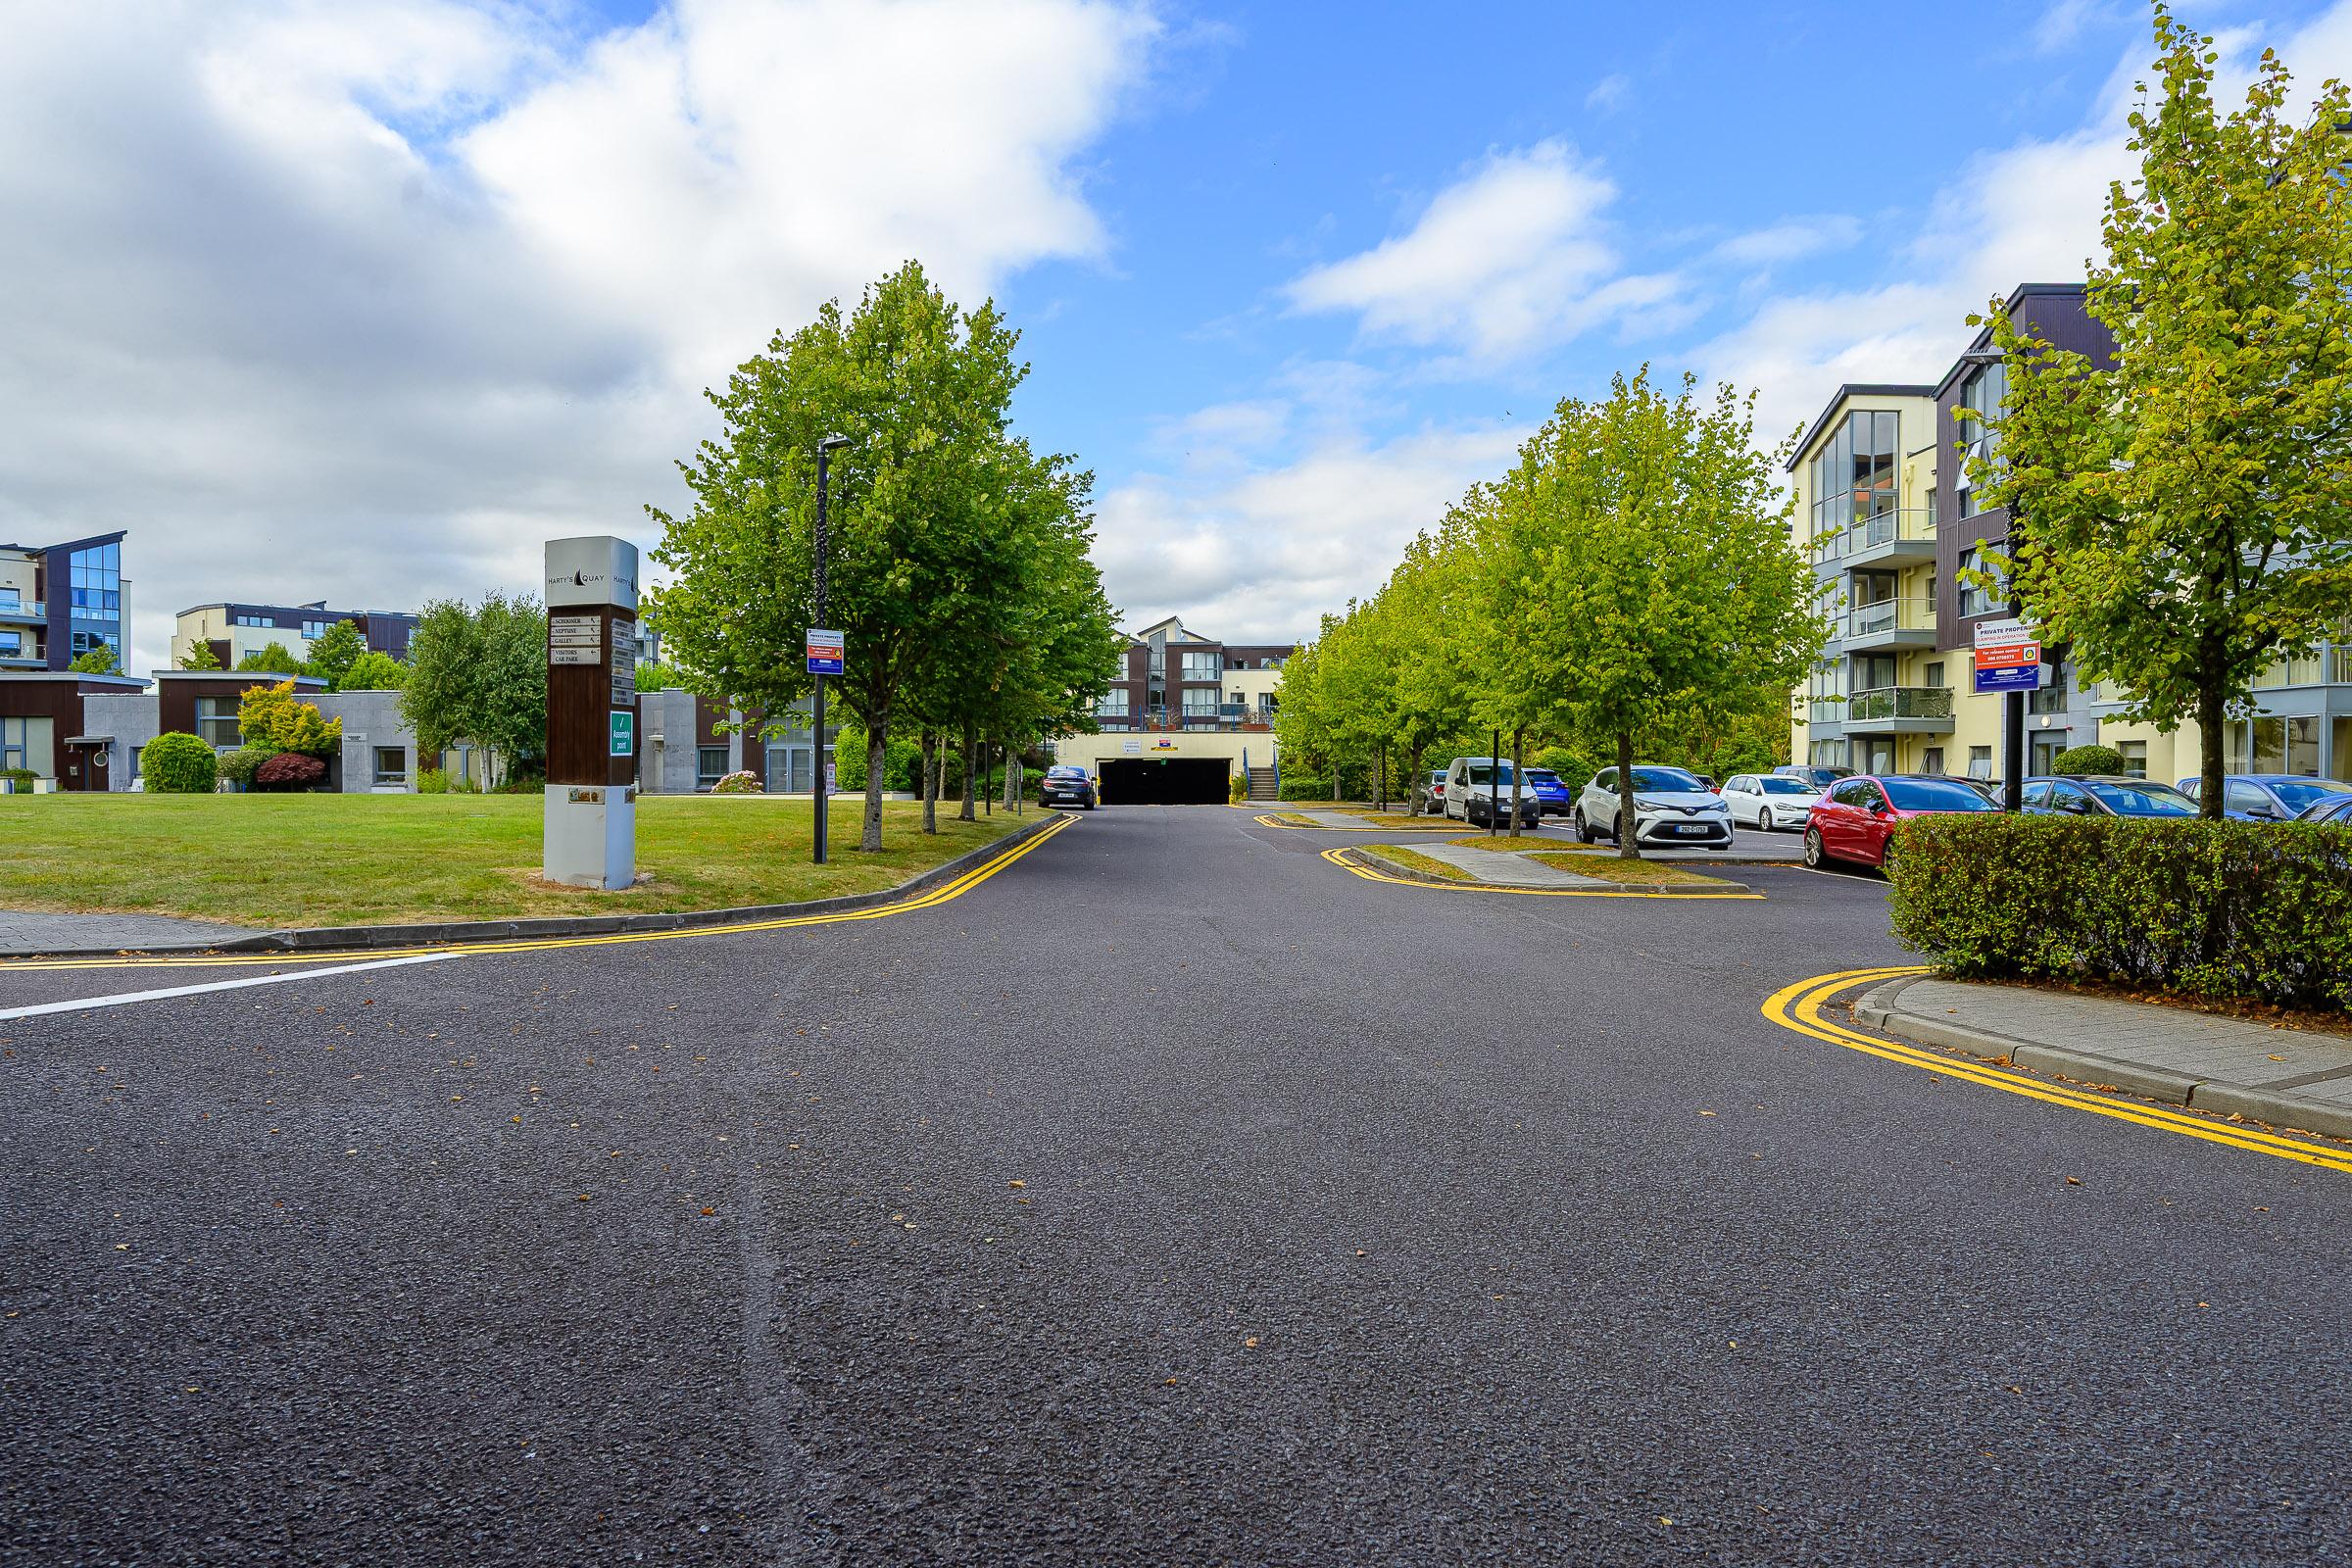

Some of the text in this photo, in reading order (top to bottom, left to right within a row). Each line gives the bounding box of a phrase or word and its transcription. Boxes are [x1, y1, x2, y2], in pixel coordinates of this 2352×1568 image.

[549, 576, 573, 585] HARTY'S
[612, 729, 630, 741] Assembly
[616, 741, 627, 752] point
